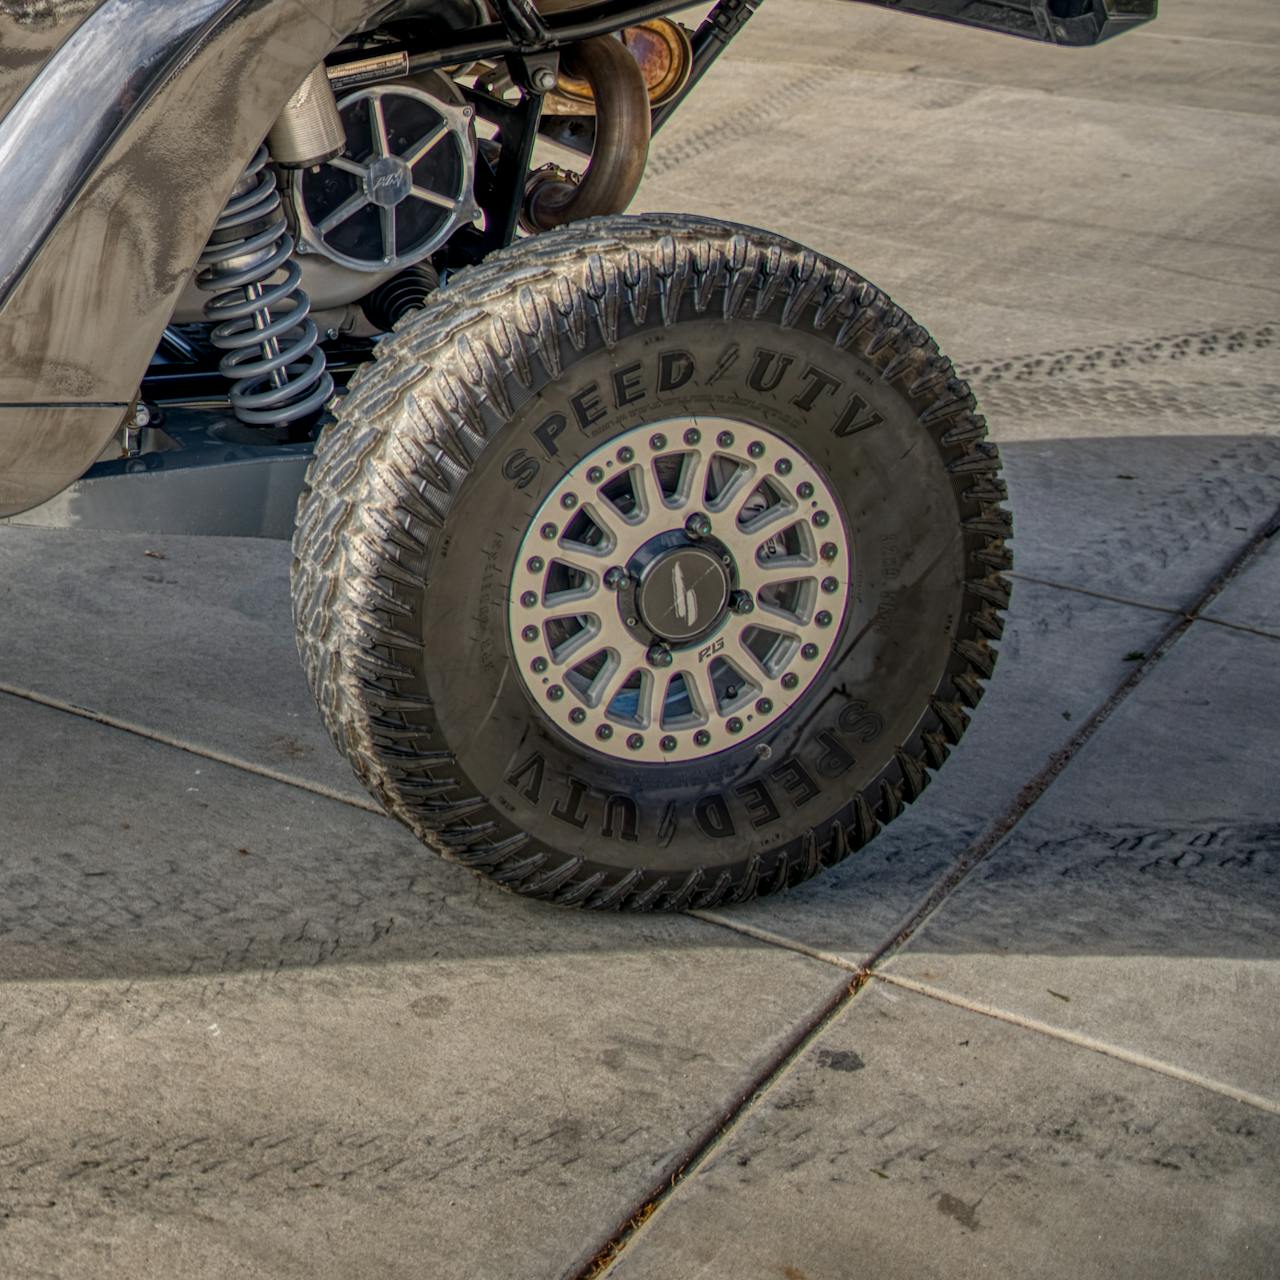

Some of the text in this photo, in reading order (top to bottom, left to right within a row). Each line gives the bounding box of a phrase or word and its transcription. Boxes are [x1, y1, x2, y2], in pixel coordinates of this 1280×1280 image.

[502, 348, 696, 490] SPEED
[744, 346, 886, 438] UTV
[504, 698, 884, 843] SPEED UTV
